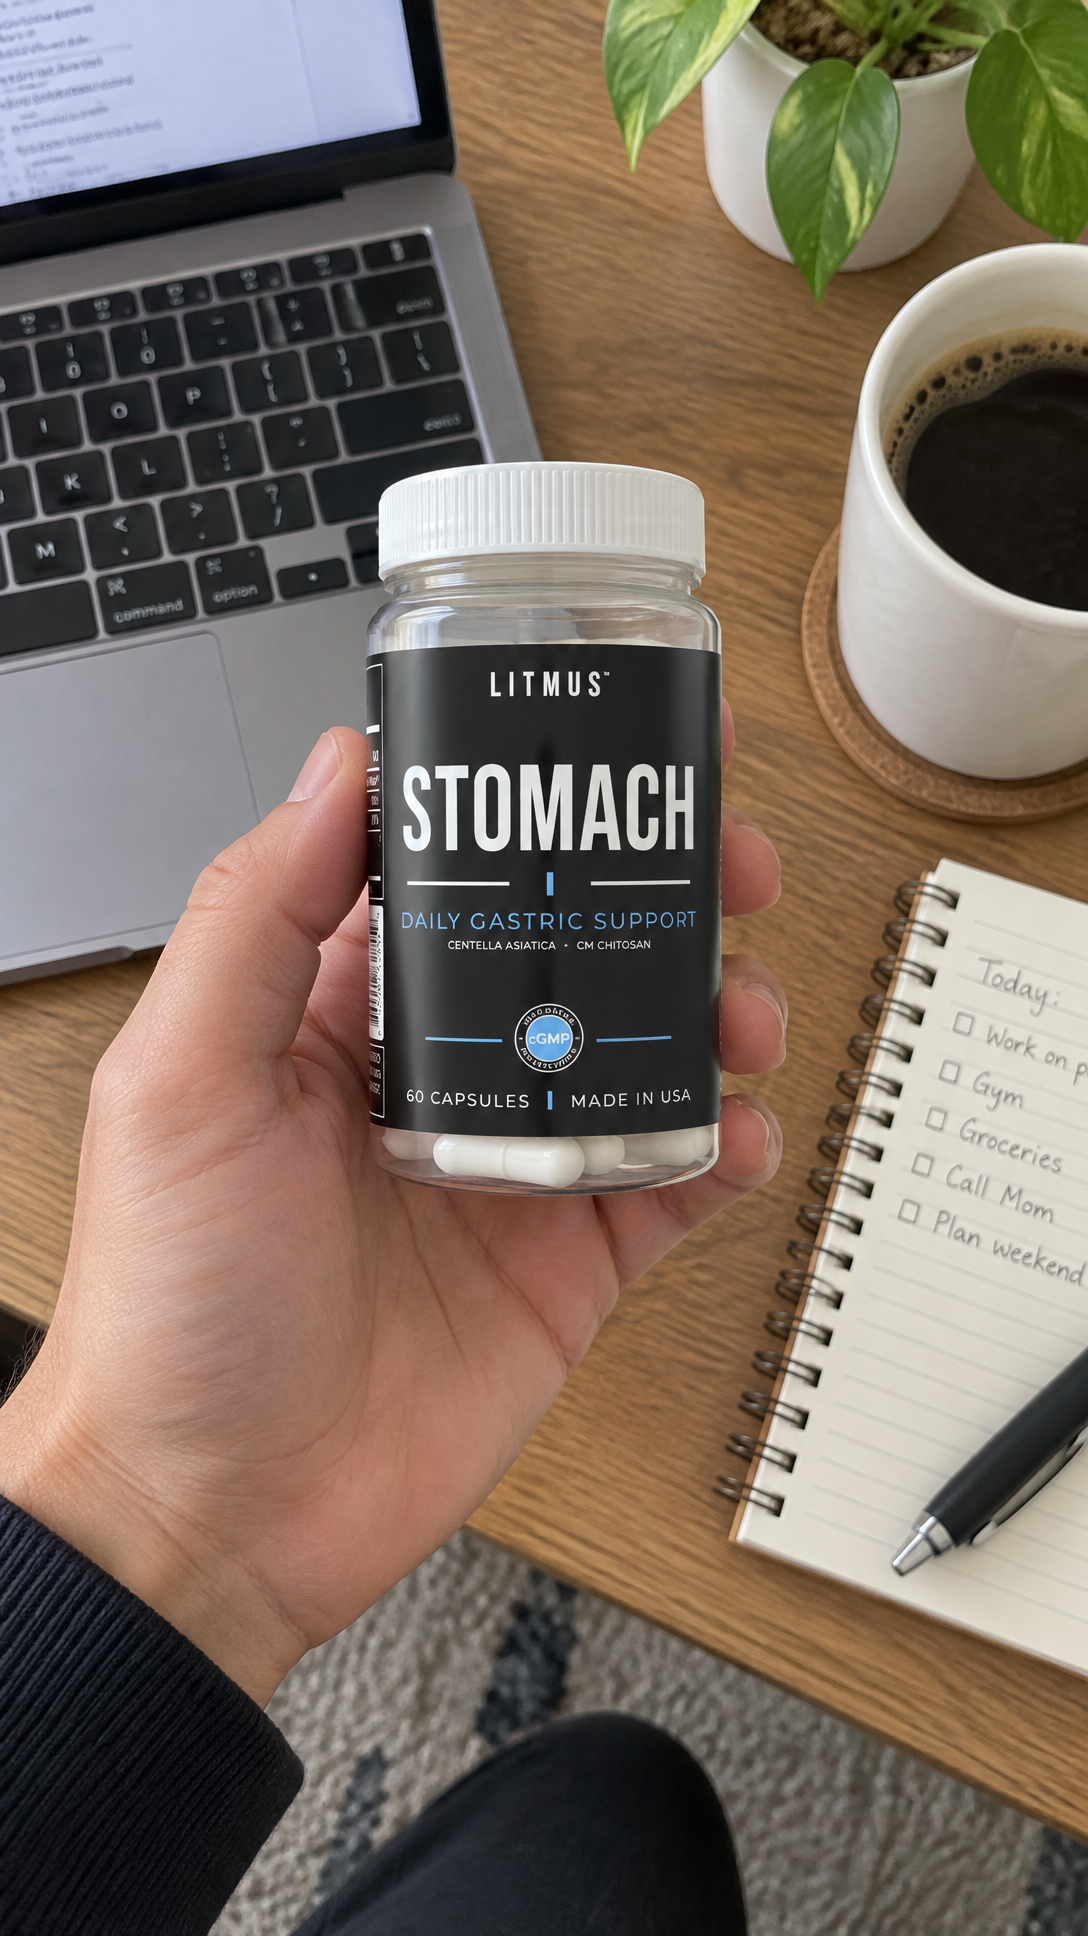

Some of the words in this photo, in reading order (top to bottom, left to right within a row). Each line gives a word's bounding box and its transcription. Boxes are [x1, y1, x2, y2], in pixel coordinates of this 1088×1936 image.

[141, 458, 156, 475] L
[63, 473, 81, 490] K
[35, 541, 56, 560] M
[212, 584, 259, 603] option
[113, 597, 184, 624] command
[402, 763, 695, 852] STOMACH
[401, 911, 461, 930] DAILY
[470, 912, 583, 931] GASTRIC
[594, 910, 696, 930] SUPPORT
[447, 940, 503, 950] CENTELLA
[504, 940, 557, 950] ASIATICA
[576, 940, 594, 950] CM
[597, 939, 651, 950] CHITOSAN
[978, 956, 1061, 1018] Today:
[528, 1032, 571, 1045] cGMP
[986, 1024, 1037, 1060] Work
[1044, 1050, 1067, 1070] on
[1072, 1061, 1088, 1087] p
[406, 1088, 424, 1104] 60
[430, 1091, 530, 1109] CAPSULES
[571, 1092, 628, 1108] MADE
[636, 1091, 653, 1106] IN
[661, 1088, 691, 1104] USA
[972, 1070, 1024, 1111] Gym
[959, 1116, 1063, 1174] Groceries
[946, 1163, 990, 1198] Call
[999, 1184, 1054, 1223] Mom
[933, 1209, 981, 1248] Plan
[993, 1238, 1087, 1287] weekend
